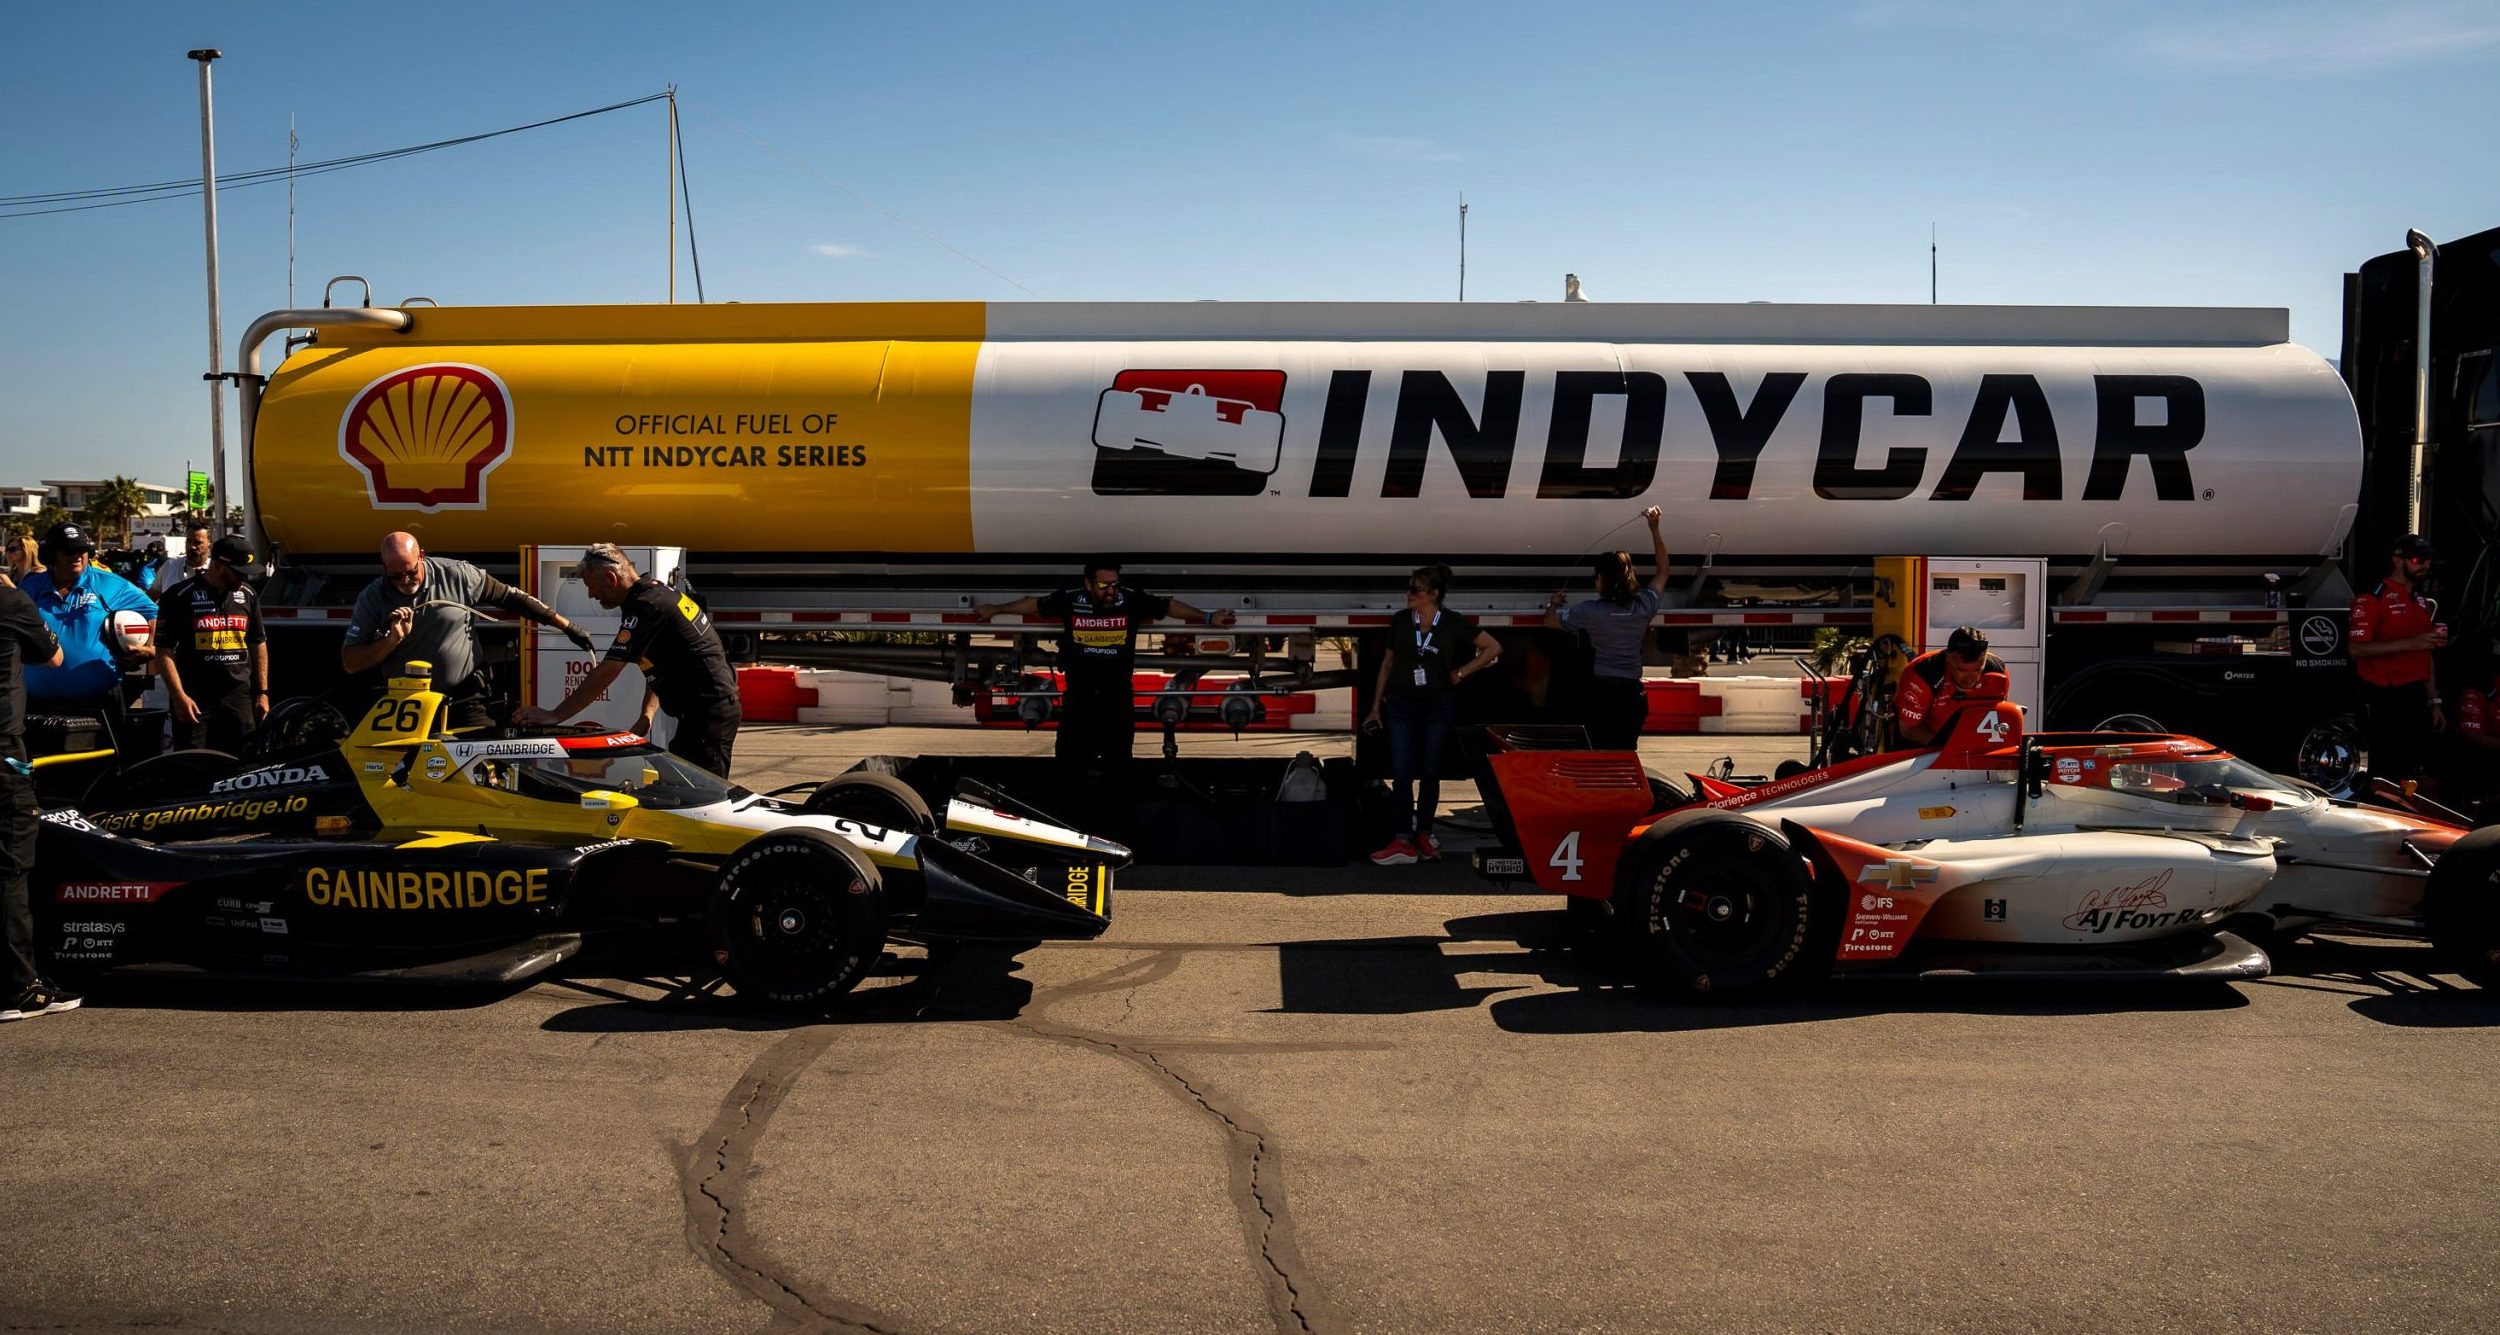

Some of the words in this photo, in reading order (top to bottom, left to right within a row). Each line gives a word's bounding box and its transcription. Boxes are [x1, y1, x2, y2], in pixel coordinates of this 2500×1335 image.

[615, 414, 726, 435] OFFICIAL
[736, 414, 793, 435] FUEL
[802, 414, 837, 434] OF
[1307, 369, 2206, 501] INDYCAR
[584, 446, 634, 467] NTT
[643, 446, 767, 467] INDYCAR
[777, 445, 867, 467] SERIES
[198, 617, 247, 629] ANDRETTI
[1075, 617, 1126, 627] ANDRETTI
[565, 661, 602, 675] 100
[2296, 659, 2308, 667] NO
[2310, 658, 2348, 667] SMOKING
[371, 699, 422, 732] 26
[1976, 710, 2006, 743] 4
[486, 743, 555, 755] GAINBRIDGE
[209, 764, 330, 794] HONDA
[1760, 770, 1829, 797] TECHNOLOGIES
[100, 812, 140, 832] visit
[142, 795, 309, 832] gainbridge.io
[1550, 831, 1584, 881] 4
[64, 886, 149, 899] ANDRETTI
[305, 867, 549, 910] GAINBRIDGE
[1648, 848, 1691, 935] Firestone
[1877, 897, 1893, 909] IFS
[63, 921, 126, 935] stratasys
[2078, 908, 2113, 934] AJ
[2114, 909, 2176, 929] FOYT
[1765, 894, 1809, 979] Firestone
[1880, 931, 1895, 939] NTT
[55, 952, 113, 961] Firestone
[1844, 943, 1893, 952] Firestone
